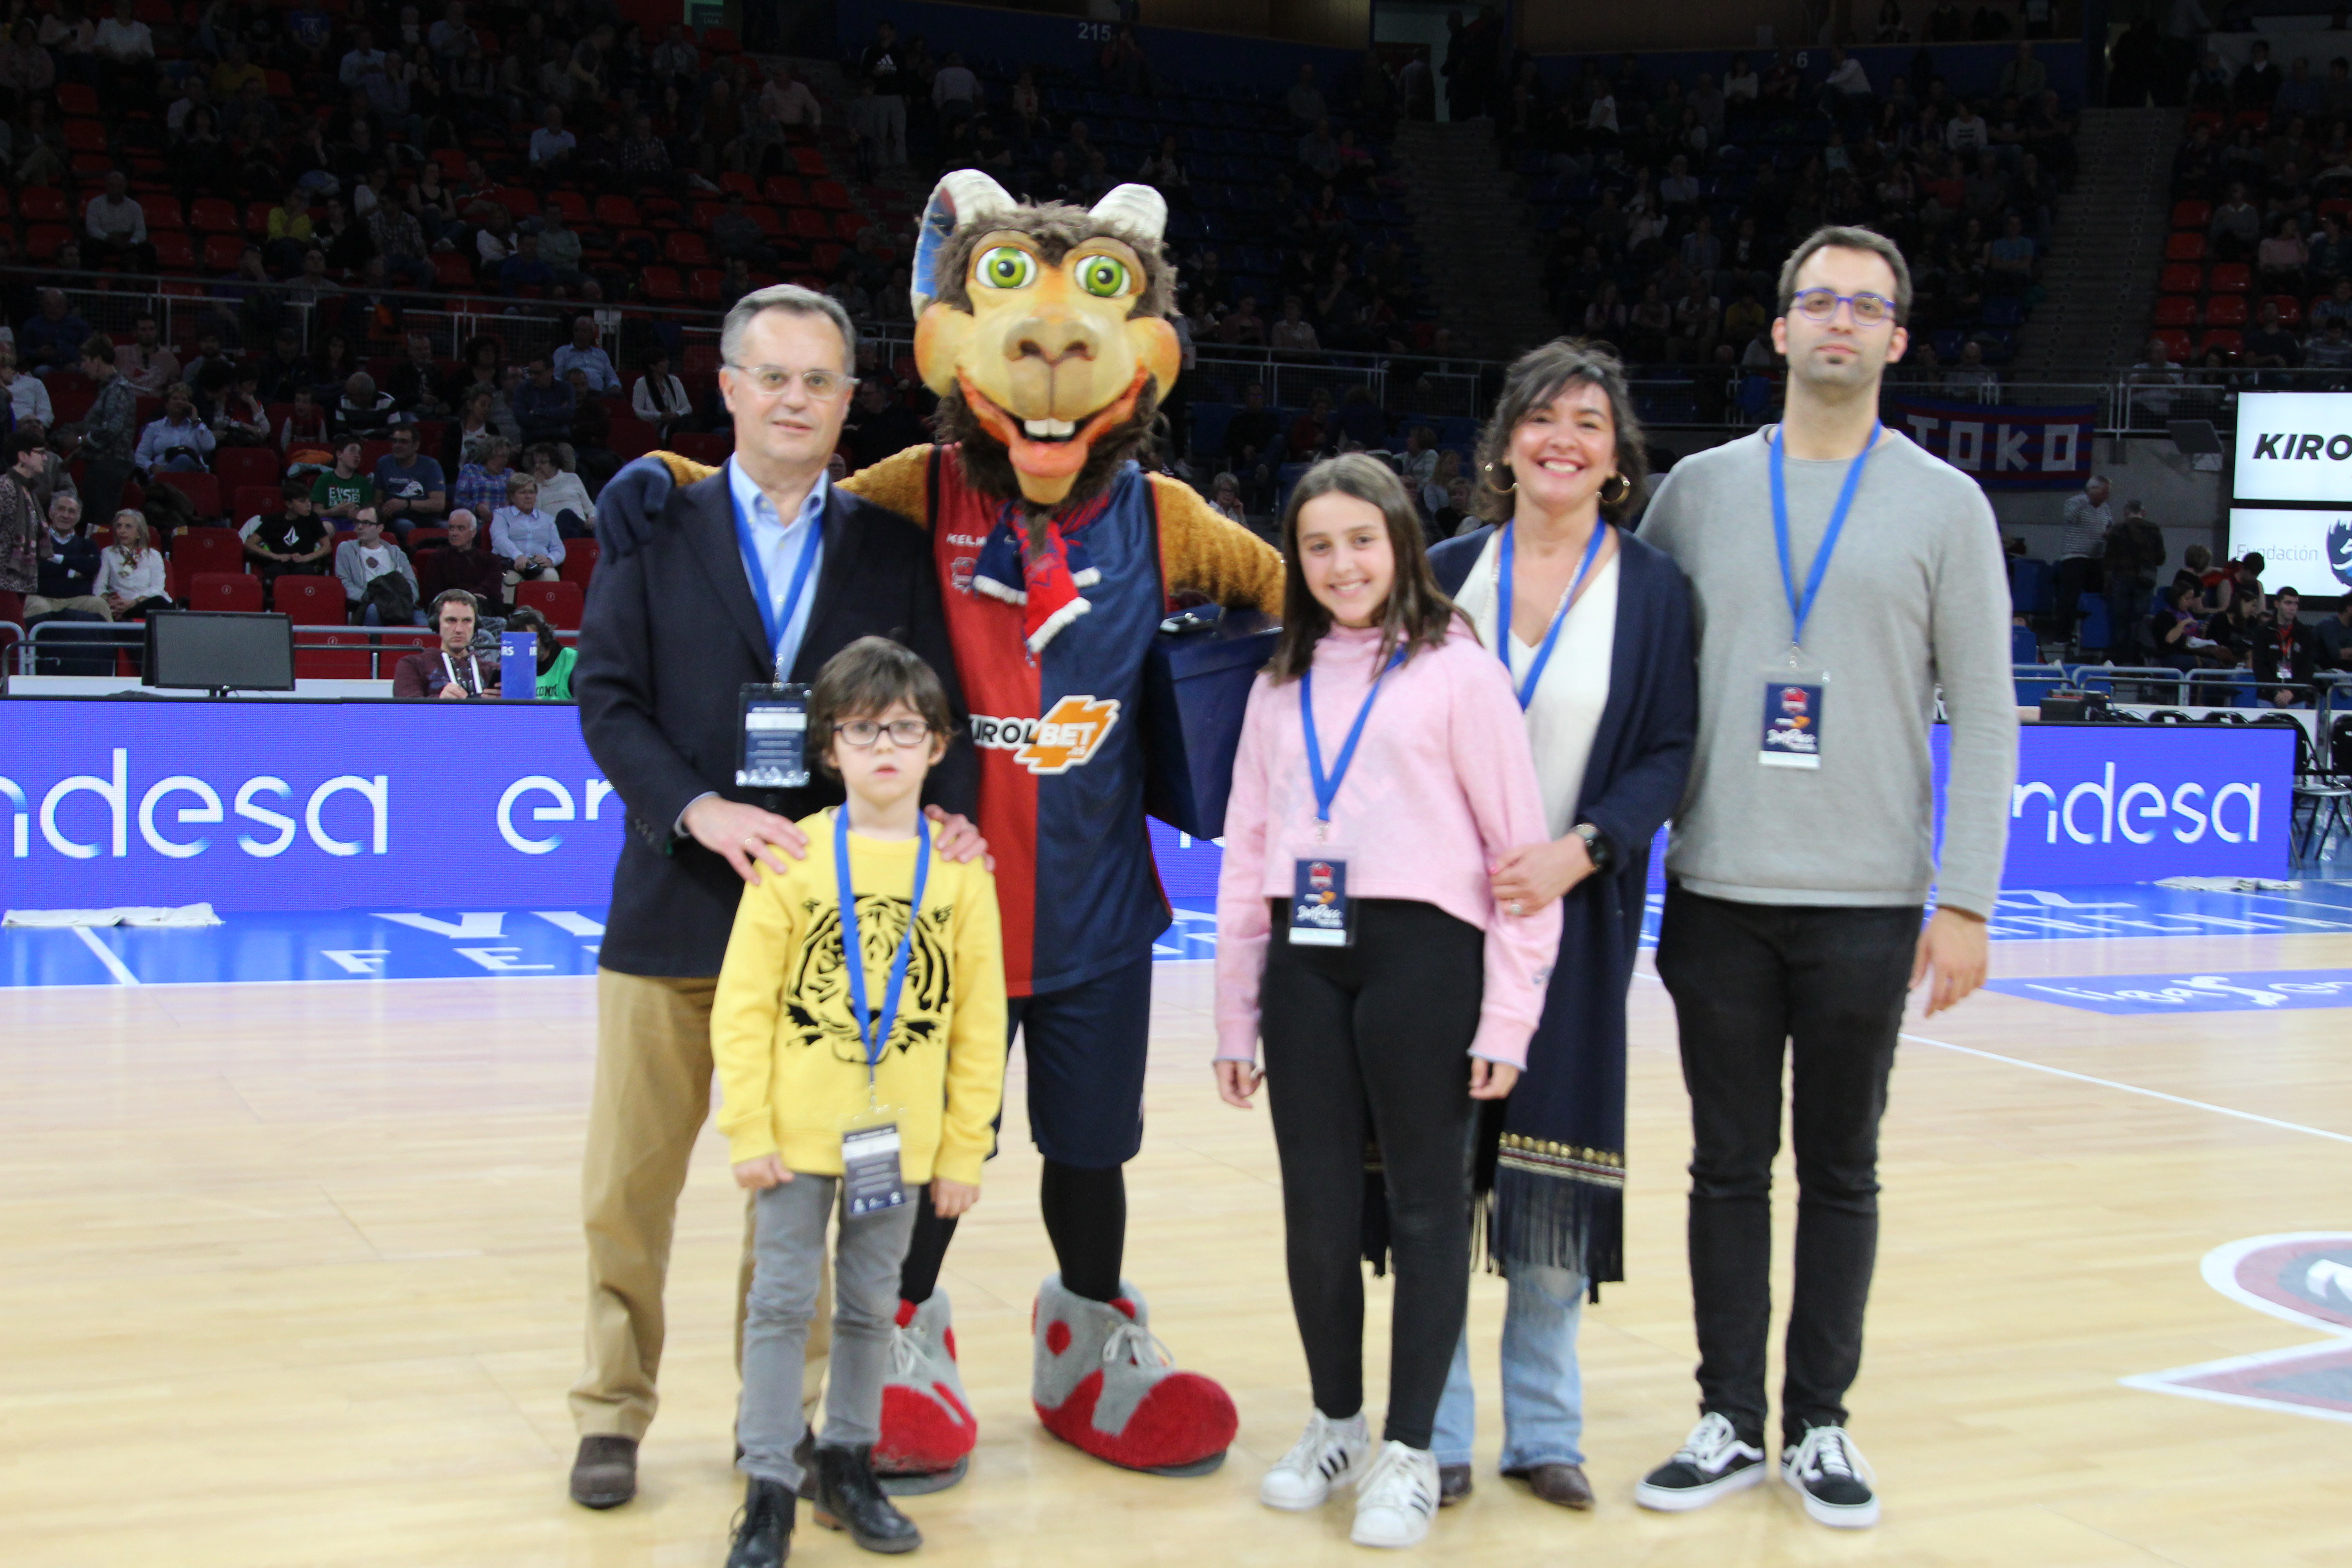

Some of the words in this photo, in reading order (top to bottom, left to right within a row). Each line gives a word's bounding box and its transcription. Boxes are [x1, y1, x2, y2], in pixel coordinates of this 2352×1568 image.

[1078, 22, 1111, 42] 215
[972, 721, 1098, 745] IROLBET
[2012, 761, 2261, 845] ndesa
